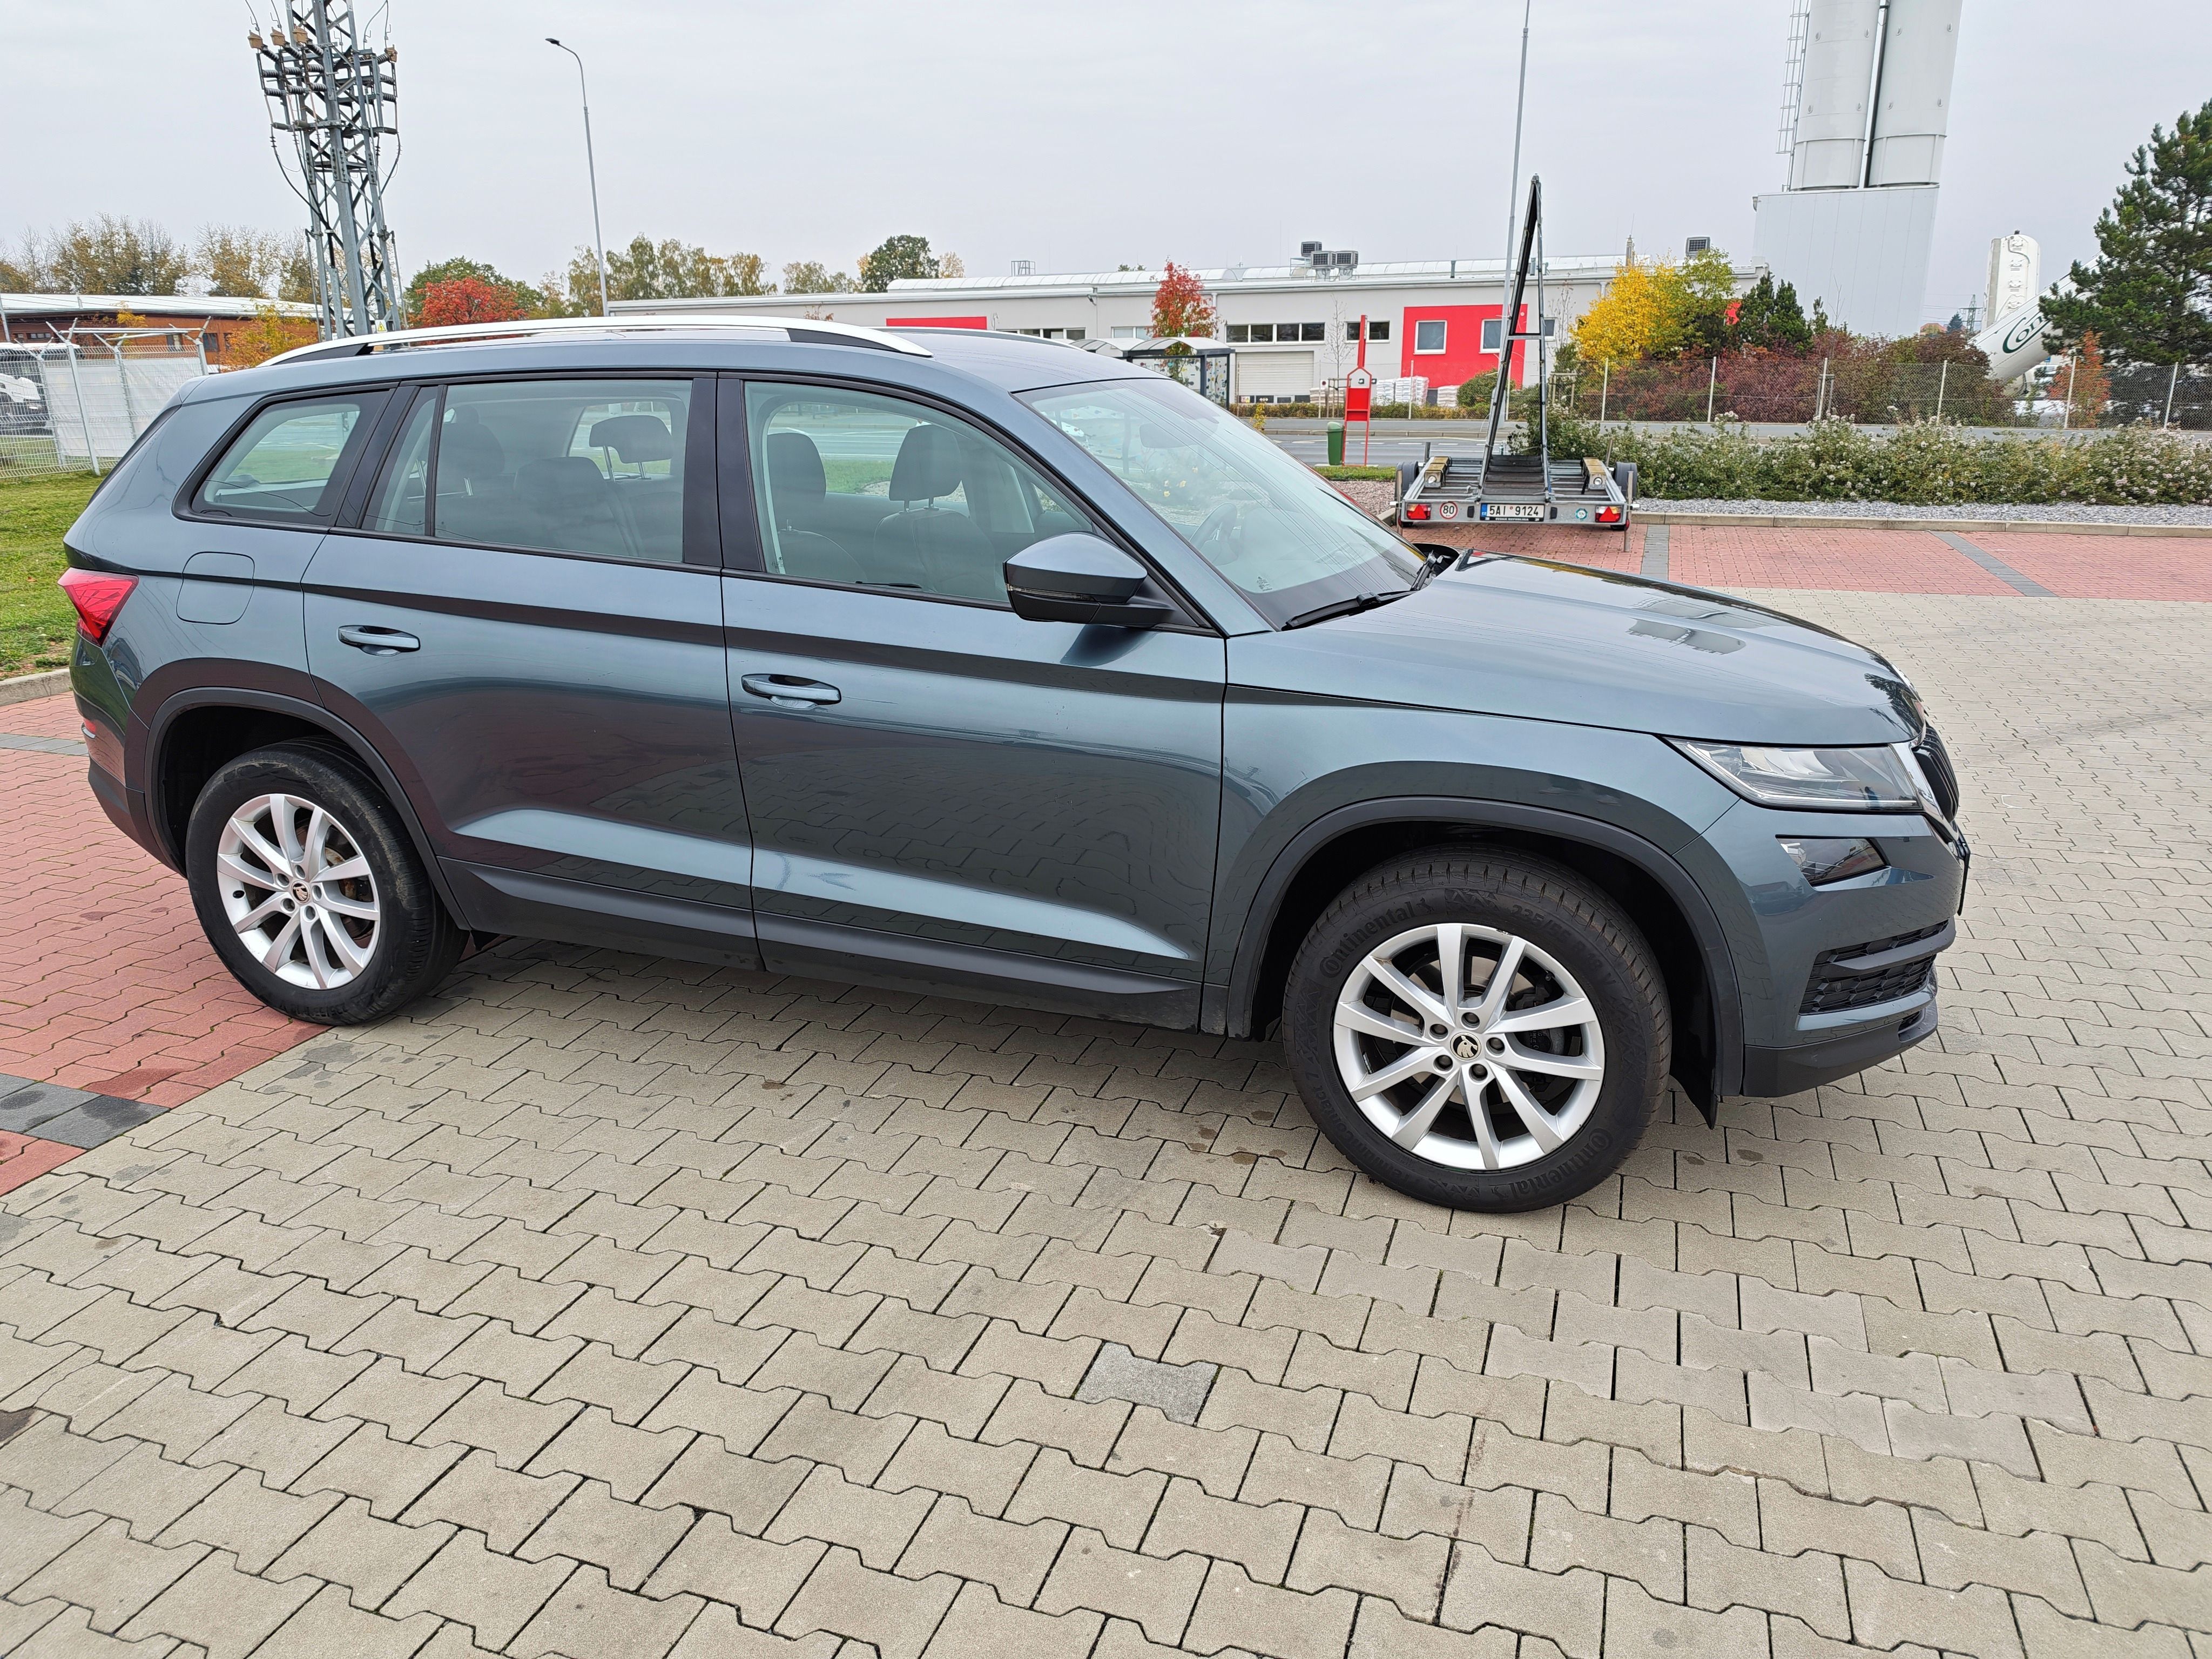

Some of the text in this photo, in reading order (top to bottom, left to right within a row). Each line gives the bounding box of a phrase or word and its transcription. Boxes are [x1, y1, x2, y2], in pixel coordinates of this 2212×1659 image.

[1443, 505, 1454, 514] 80
[1515, 506, 1539, 516] 9124
[1319, 901, 1416, 978] Continental
[1509, 1127, 1614, 1198] Continental
